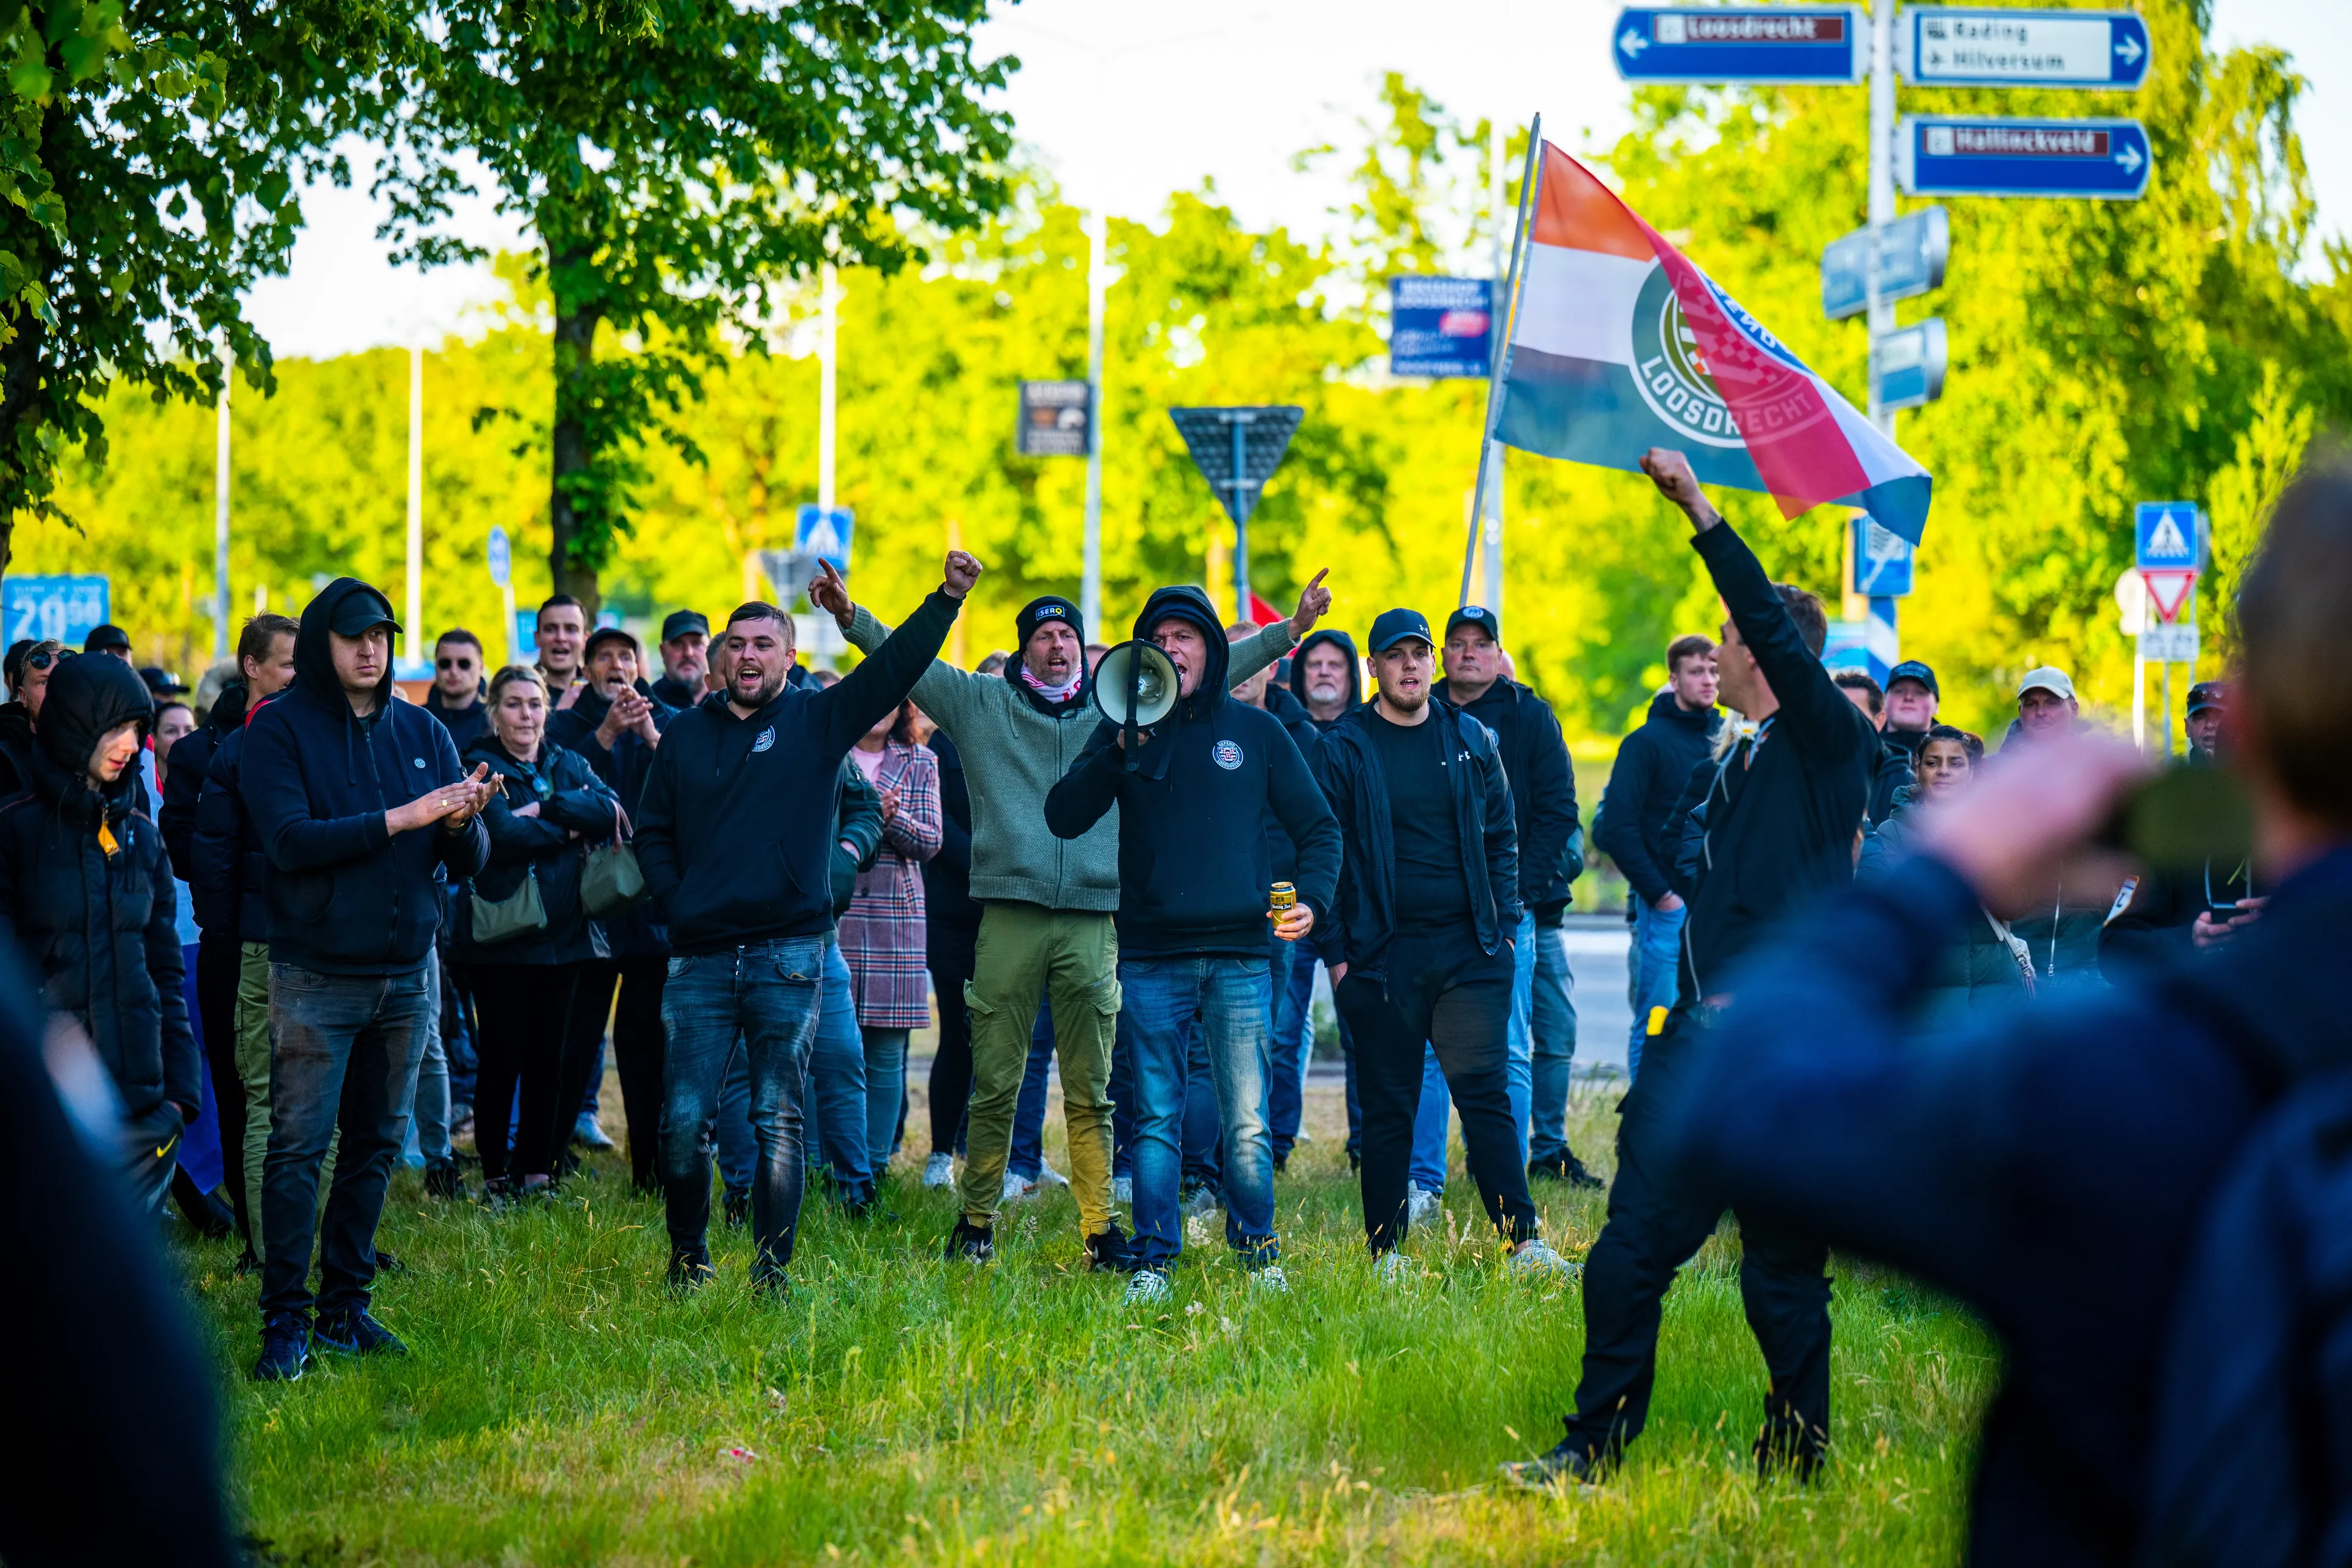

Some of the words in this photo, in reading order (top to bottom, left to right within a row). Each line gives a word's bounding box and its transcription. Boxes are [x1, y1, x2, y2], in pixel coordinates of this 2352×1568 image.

[1687, 15, 1817, 39] Loosdrecht
[1953, 21, 2028, 45] Rading
[1953, 48, 2065, 71] Hilversum
[1640, 355, 1812, 435] LOOSDRECHT
[1038, 607, 1063, 617] ISERO
[1217, 760, 1241, 768] LOOSDRECHT
